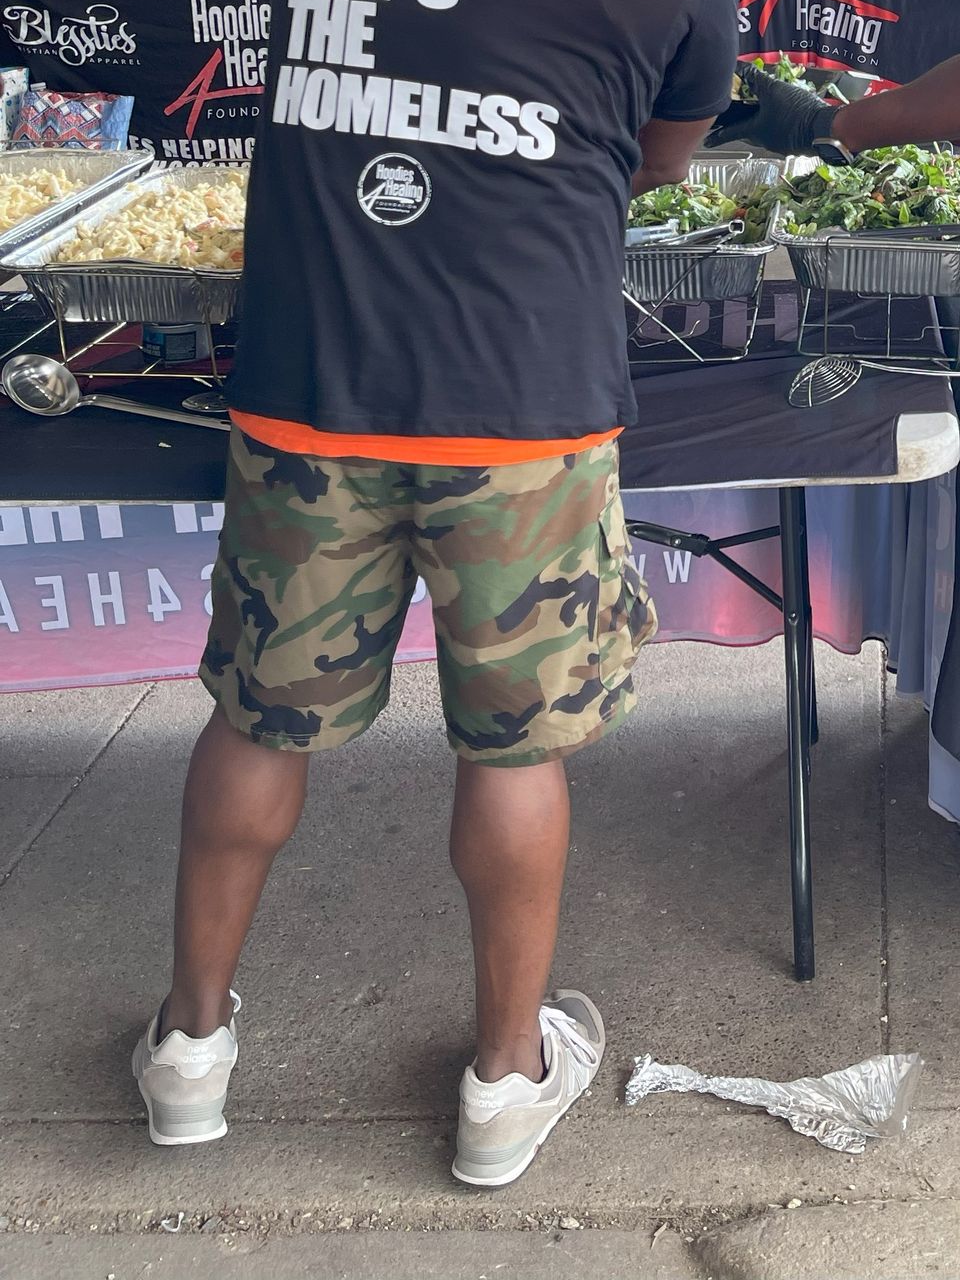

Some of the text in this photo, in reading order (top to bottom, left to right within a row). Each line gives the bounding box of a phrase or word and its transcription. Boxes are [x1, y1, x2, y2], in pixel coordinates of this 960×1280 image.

[17, 45, 58, 55] ISTIAN
[791, 39, 880, 67] FOUDATION
[89, 57, 142, 66] APPAREL
[207, 106, 260, 119] FOUND
[272, 65, 560, 160] HOMELESS
[375, 163, 415, 183] Hoodies
[384, 180, 424, 202] Healing
[187, 1046, 209, 1054] new
[475, 1089, 496, 1099] new
